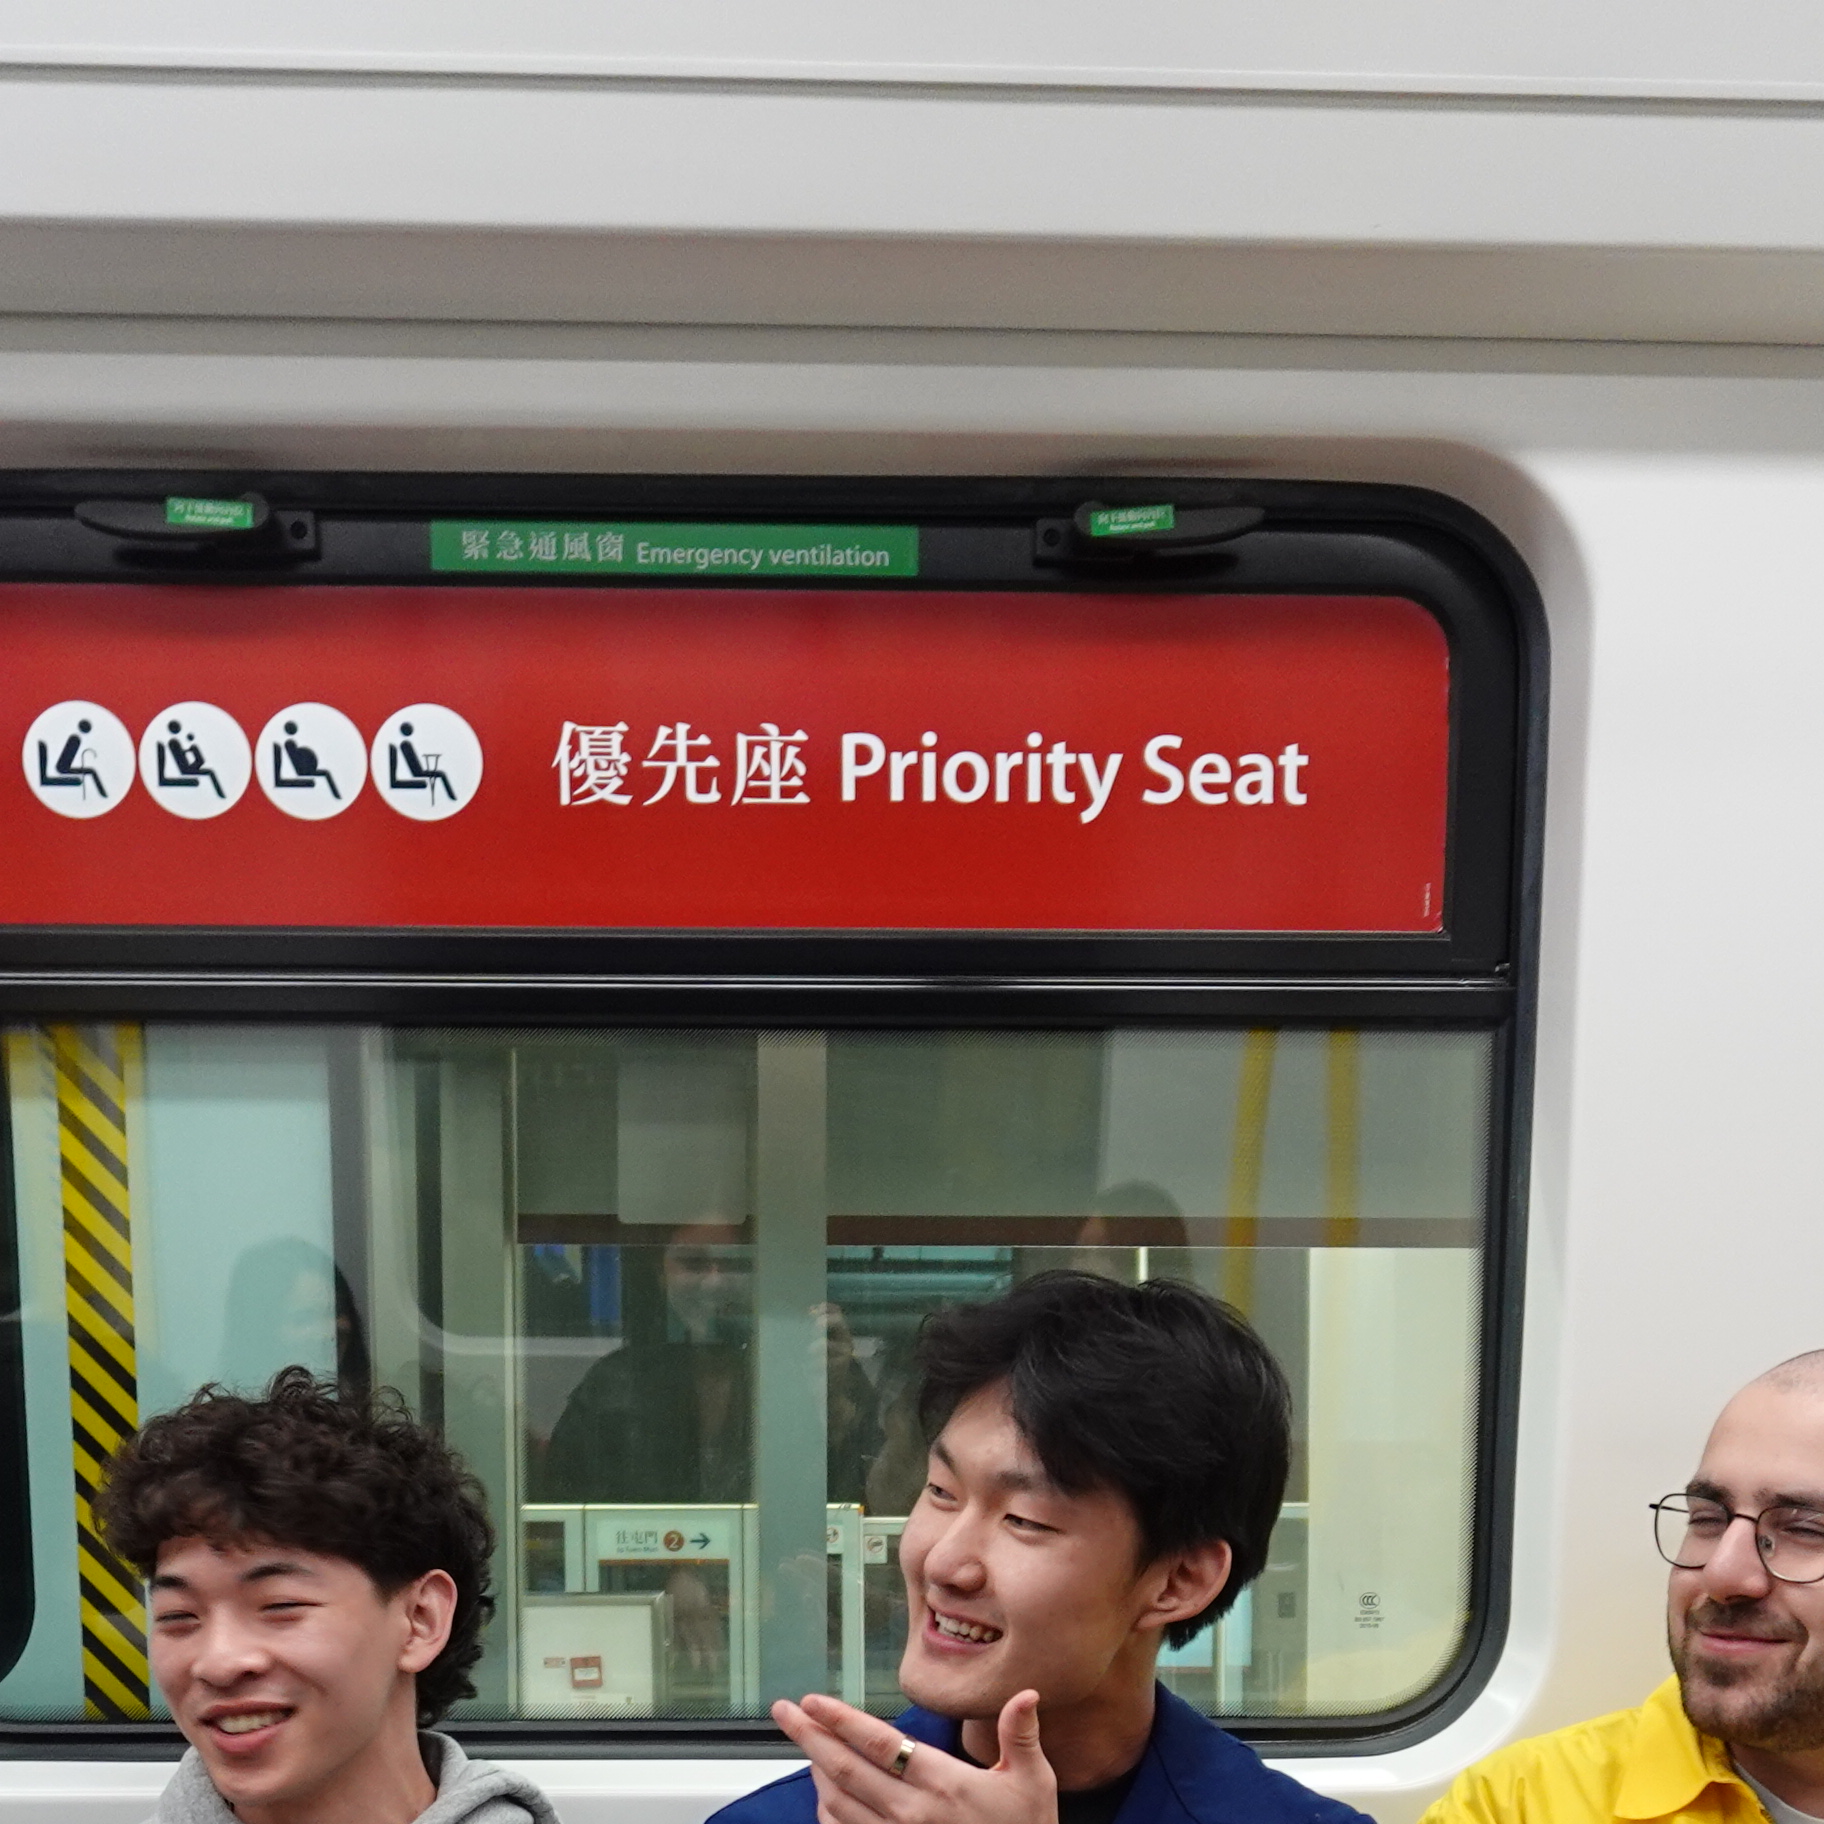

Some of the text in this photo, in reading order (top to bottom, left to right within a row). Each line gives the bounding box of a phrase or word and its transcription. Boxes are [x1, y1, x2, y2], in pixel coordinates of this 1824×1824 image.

[636, 541, 890, 570] Emergency ventilation
[550, 719, 813, 807] 優先座
[841, 730, 1310, 825] Priority Seat
